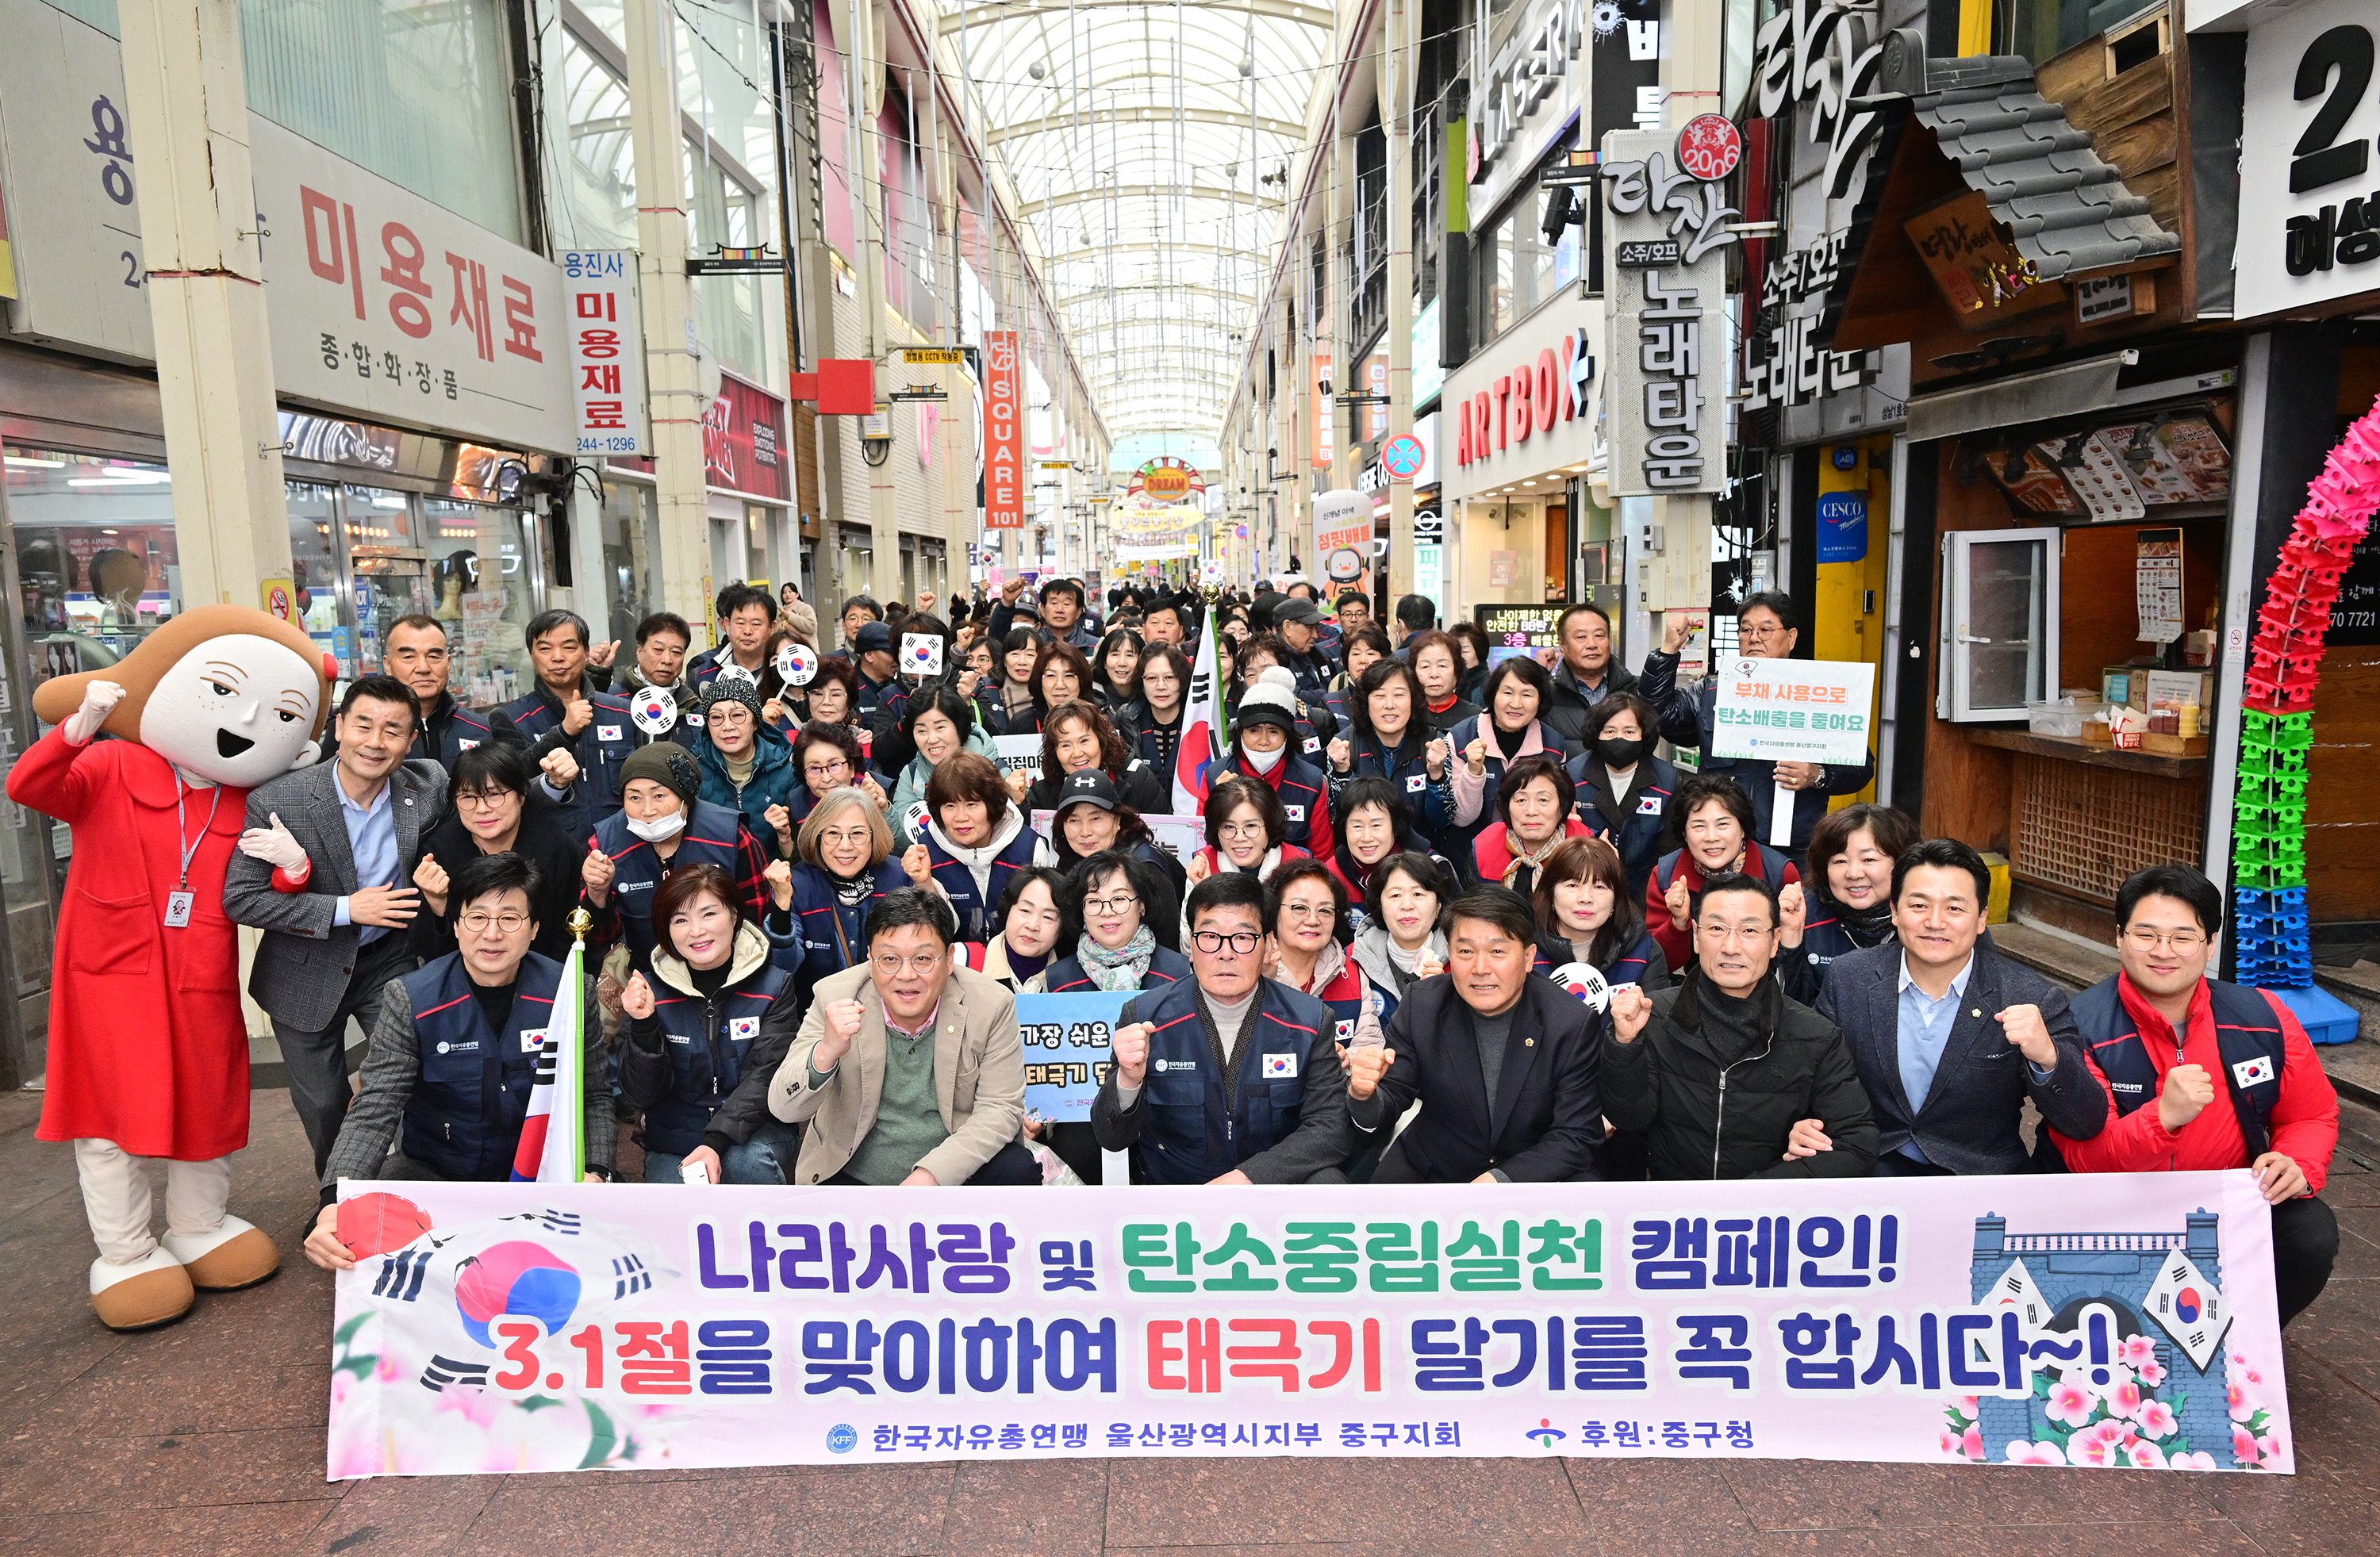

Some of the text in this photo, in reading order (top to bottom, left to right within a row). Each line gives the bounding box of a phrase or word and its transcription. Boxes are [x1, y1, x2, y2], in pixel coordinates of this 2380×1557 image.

[1683, 144, 1741, 178] 2006
[1599, 151, 1741, 265] 타잔
[1621, 241, 1679, 263] 소주/호프
[299, 183, 543, 365] 미용재료
[564, 252, 624, 278] 용진사
[575, 292, 627, 429] 미용재료
[906, 351, 923, 362] 방범용
[924, 351, 940, 362] CCTV
[1639, 268, 1705, 488] 노래타운
[1457, 332, 1593, 466] ARTBOX
[576, 436, 636, 451] 244-1296
[992, 380, 1018, 525] SQUARE 101
[1148, 477, 1185, 491] DREAM
[1322, 505, 1355, 520] 신개념 이색
[1822, 501, 1862, 518] CESCO
[1318, 524, 1371, 551] 점핑배틀
[1486, 619, 1548, 632] 안전한 BB탄
[2348, 611, 2376, 627] 7721
[1503, 632, 1527, 647] 3층
[1735, 682, 1847, 704] 부채 사용으로
[1718, 707, 1864, 732] 탄소배출을 줄여요
[1759, 739, 1795, 748] 한국자유총연맹
[451, 1041, 479, 1050] 한국자유총연맹
[1020, 1021, 1109, 1049] 가장 쉬운
[1025, 1064, 1087, 1087] 태극기
[2112, 1083, 2143, 1092] 한국자유총연맹
[697, 1214, 1898, 1296] 나라사랑 및 탄소중립실천 캠페인!
[494, 1311, 2110, 1396] 3.1절을 맞이하여 태극기 달기를 꼭 합시다~!
[831, 1436, 852, 1448] KFF
[873, 1421, 1461, 1452] 한국자유총연맹 울산광역시지부 중구지회
[1581, 1419, 1755, 1449] 후원:중구청
